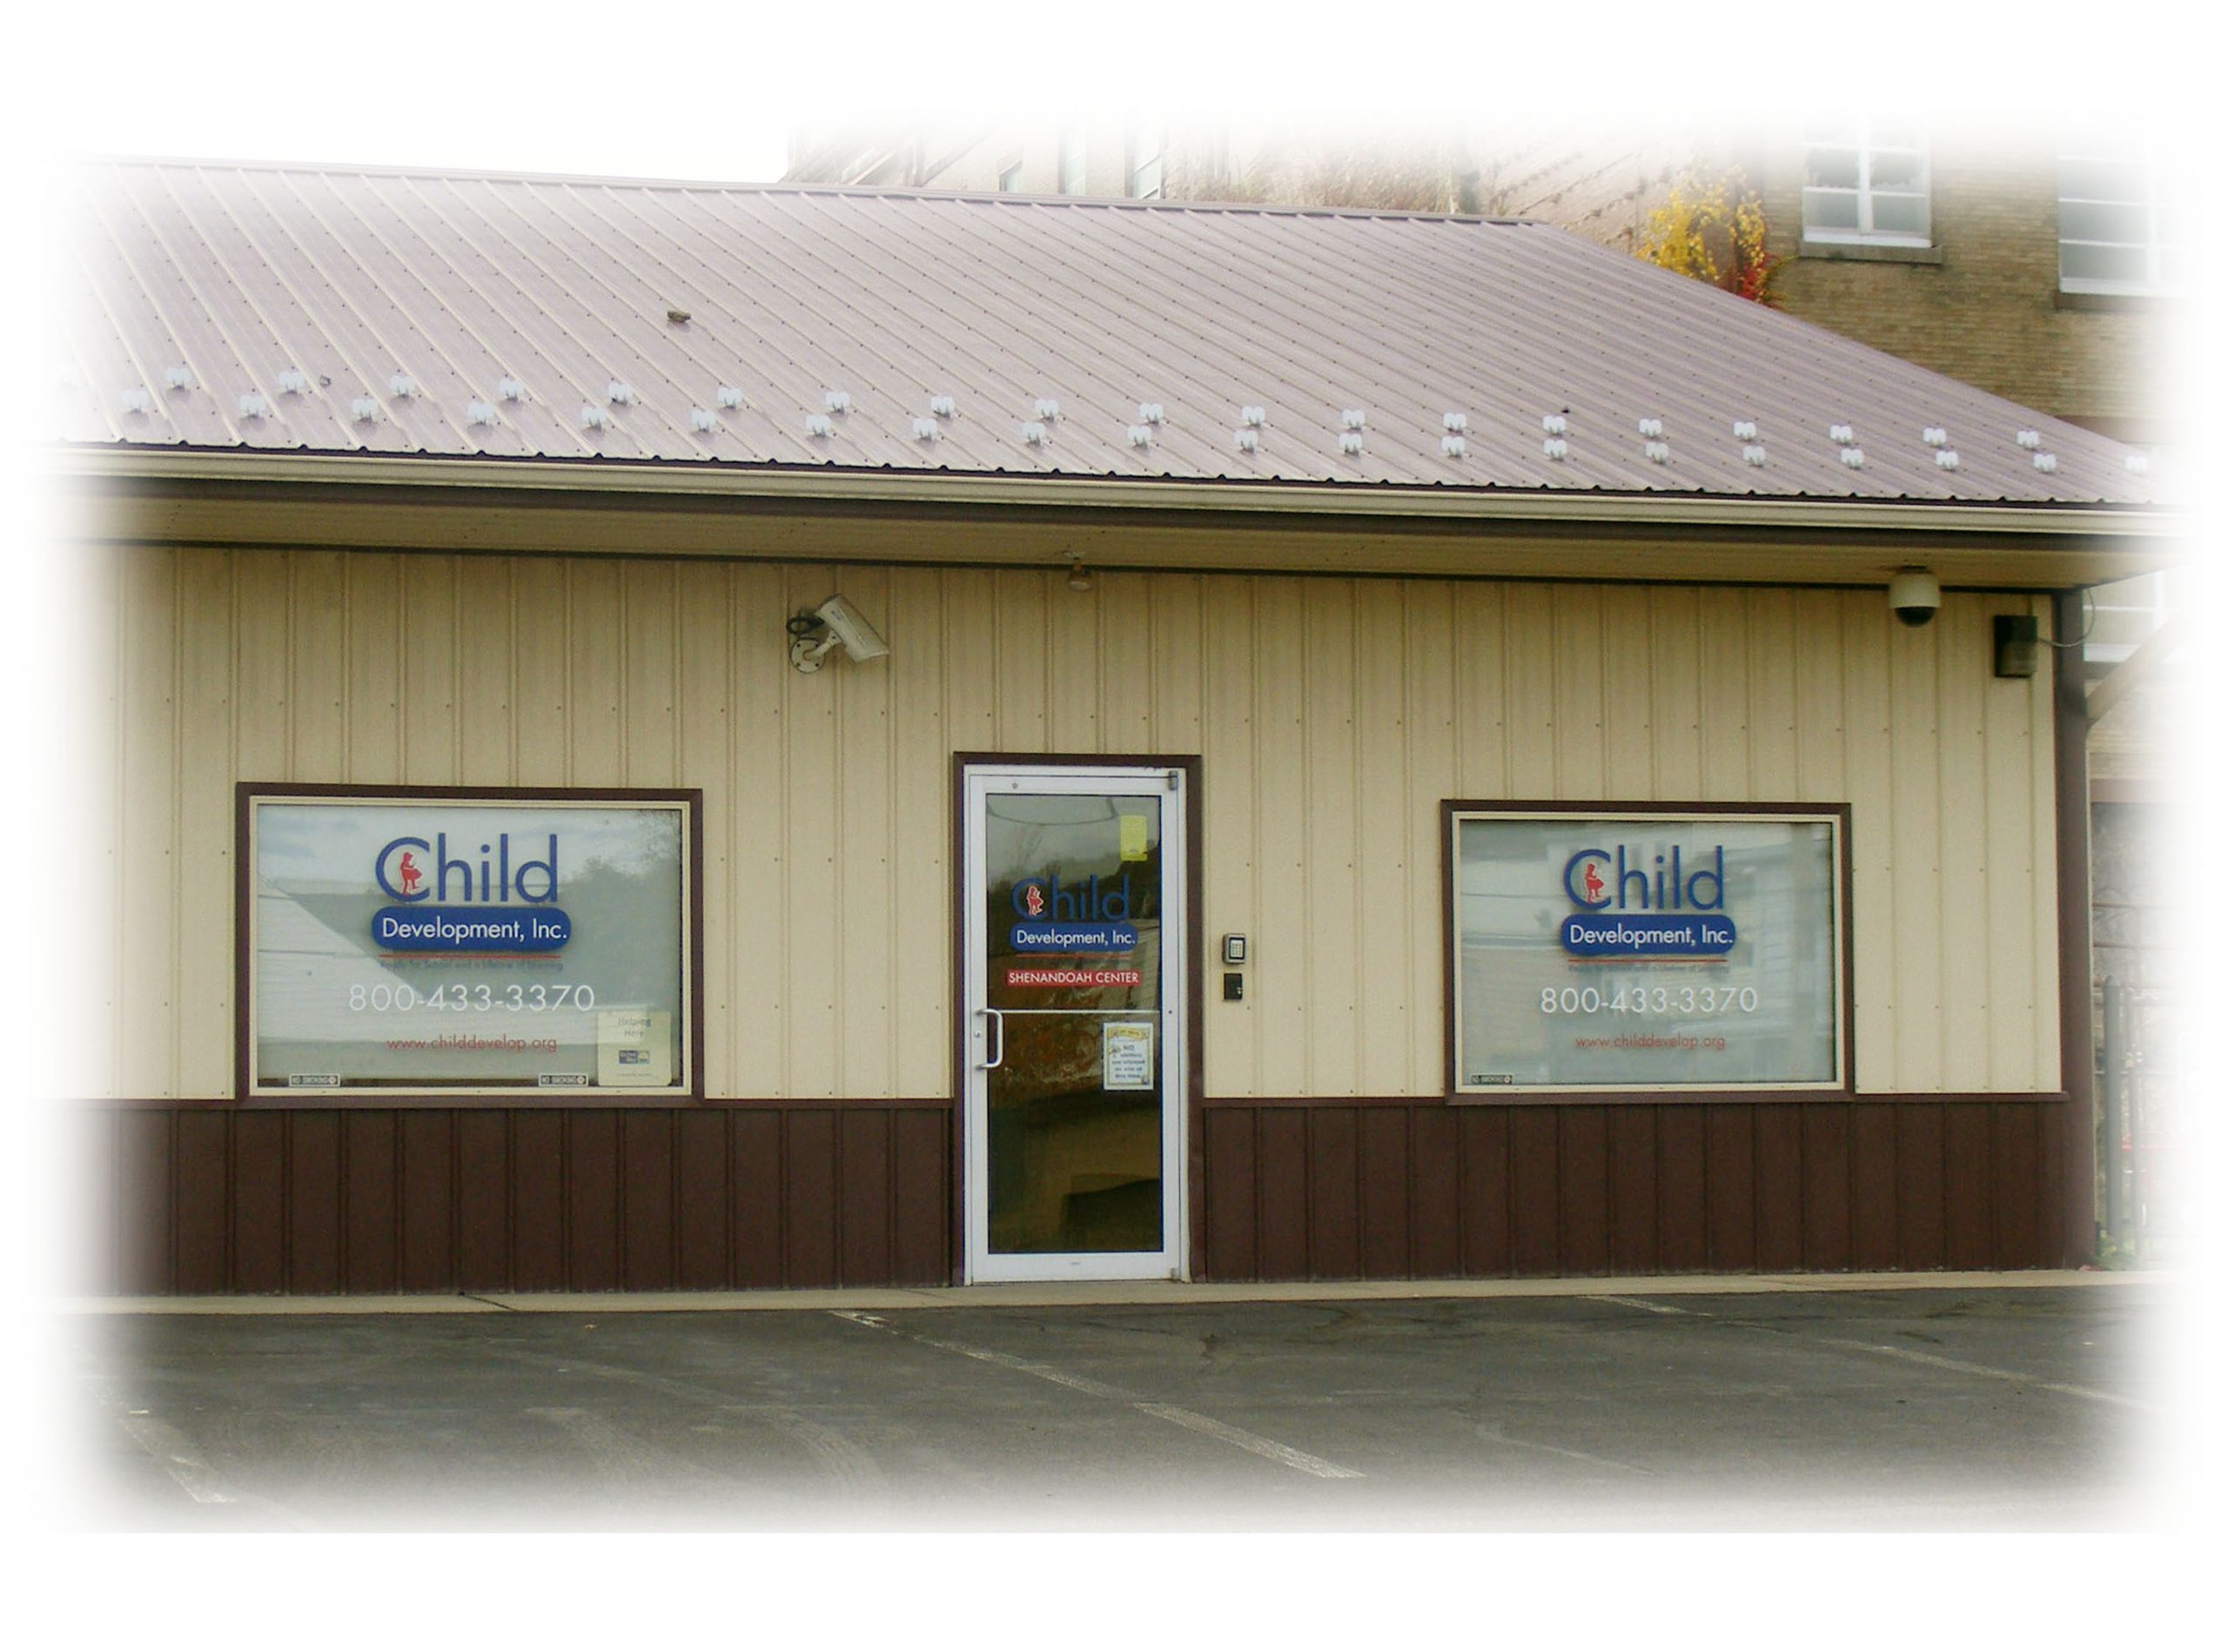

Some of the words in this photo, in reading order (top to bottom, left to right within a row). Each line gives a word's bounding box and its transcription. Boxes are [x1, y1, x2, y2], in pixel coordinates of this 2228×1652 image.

[375, 832, 558, 903] Child
[1563, 844, 1724, 910] Child
[1010, 873, 1130, 921] Child
[382, 916, 526, 944] Development,
[533, 919, 567, 940] Inc.
[1017, 928, 1109, 948] Development,
[1112, 930, 1136, 944] Inc.
[1570, 923, 1695, 949] Development,
[1701, 924, 1734, 944] Inc.
[1009, 971, 1092, 984] SHENANDOAH
[1095, 971, 1139, 984] CENTER
[349, 984, 595, 1012] 800-433-3370
[1540, 987, 1758, 1014] 800-433-3370
[386, 1033, 558, 1053] www.childdevelop.org
[1574, 1032, 1726, 1051] www.childdevelop.org
